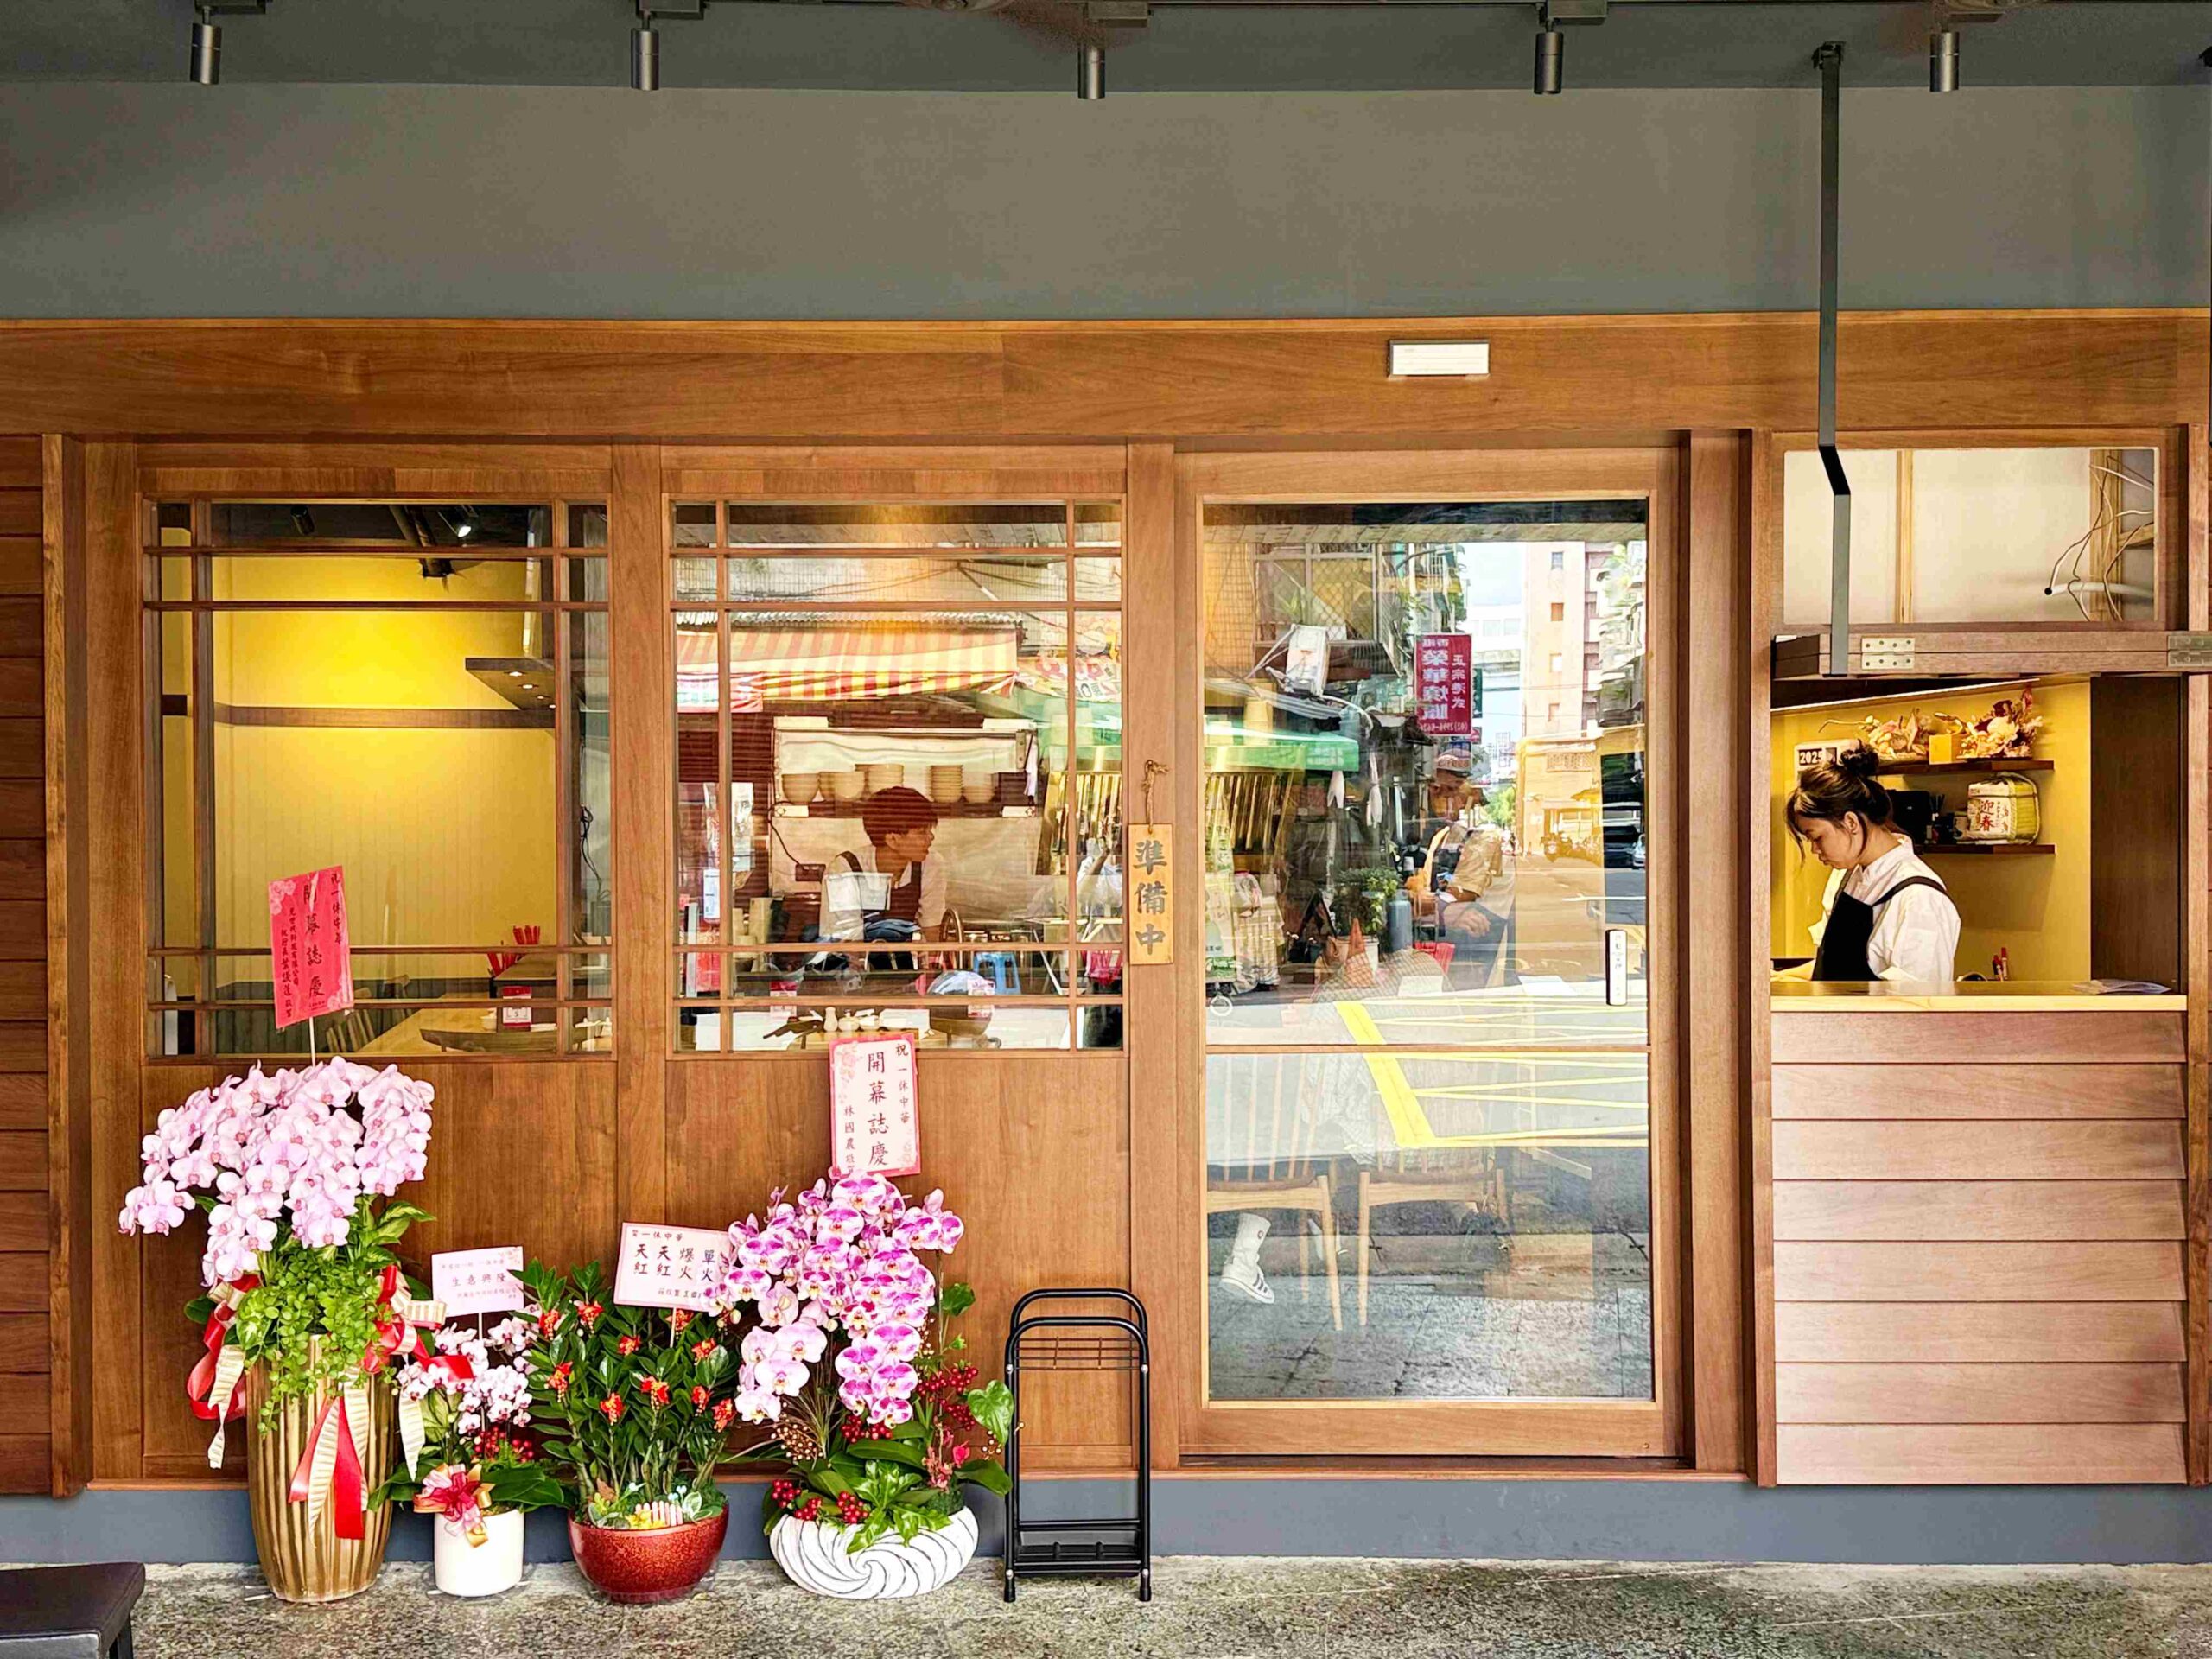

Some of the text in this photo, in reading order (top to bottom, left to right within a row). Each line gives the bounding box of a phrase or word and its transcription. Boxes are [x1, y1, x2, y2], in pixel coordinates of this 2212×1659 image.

[1980, 800, 1995, 831] 迎春
[1133, 839, 1168, 956] 準備中
[303, 884, 325, 1000] 開幕誌慶
[867, 1051, 890, 1166] 開幕誌慶
[895, 1043, 911, 1124] 祝一休中華
[633, 1262, 714, 1282] 紅紅火火
[634, 1243, 716, 1265] 天天爆單
